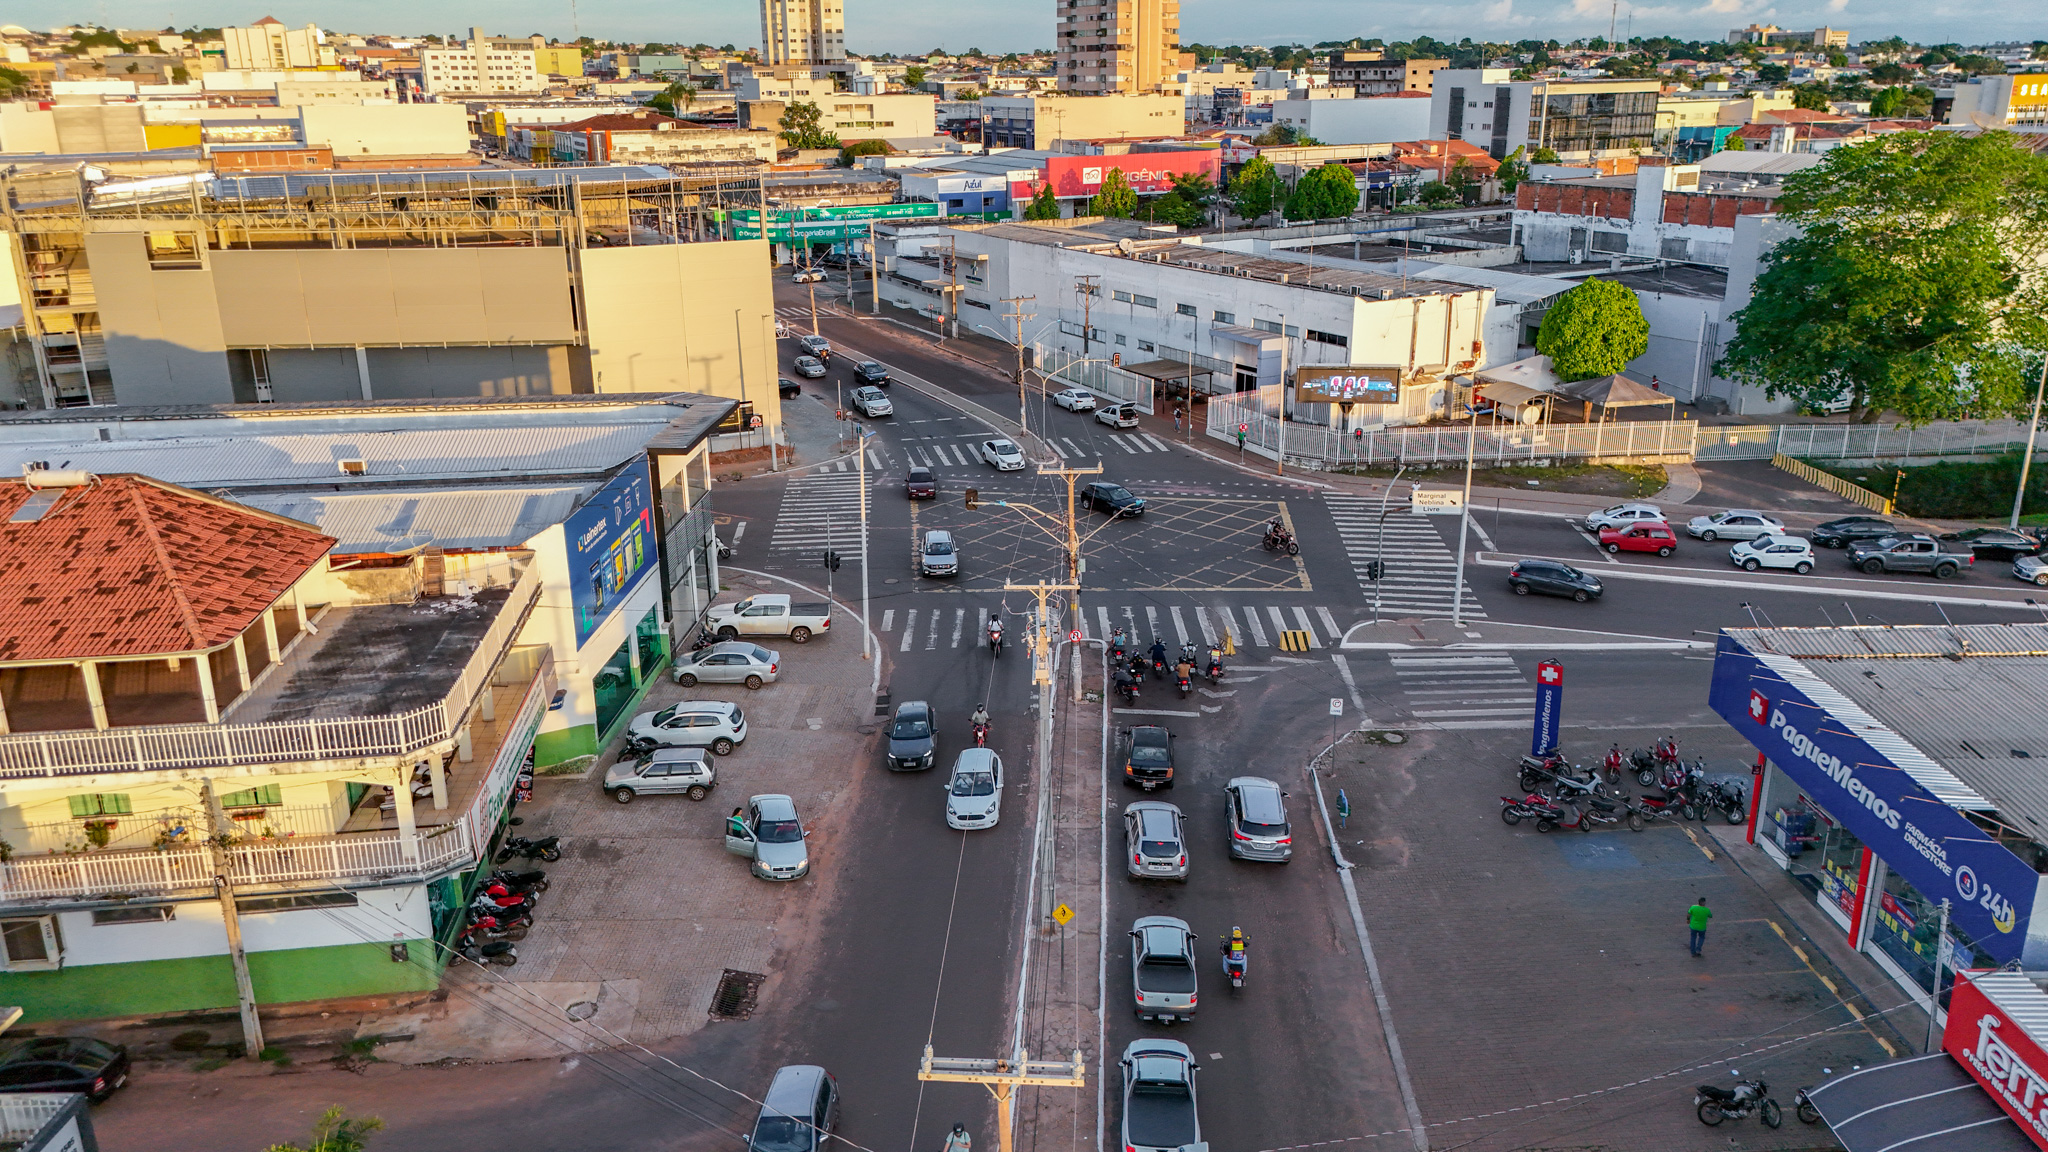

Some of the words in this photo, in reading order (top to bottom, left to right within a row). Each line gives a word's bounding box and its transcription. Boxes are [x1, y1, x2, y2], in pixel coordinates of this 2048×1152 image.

[583, 517, 607, 546] Leinertex
[1537, 689, 1553, 755] PagueMenos
[1769, 708, 1902, 830] PagueMenos
[1903, 833, 1953, 877] DRUGSTORE
[1904, 821, 1947, 861] FARMÁCIA
[1979, 883, 2012, 927] 24h
[1962, 1048, 1970, 1058] O
[1968, 1054, 1993, 1080] PREÇO
[1991, 1077, 2004, 1093] NA
[2003, 1089, 2033, 1123] MEDIDA
